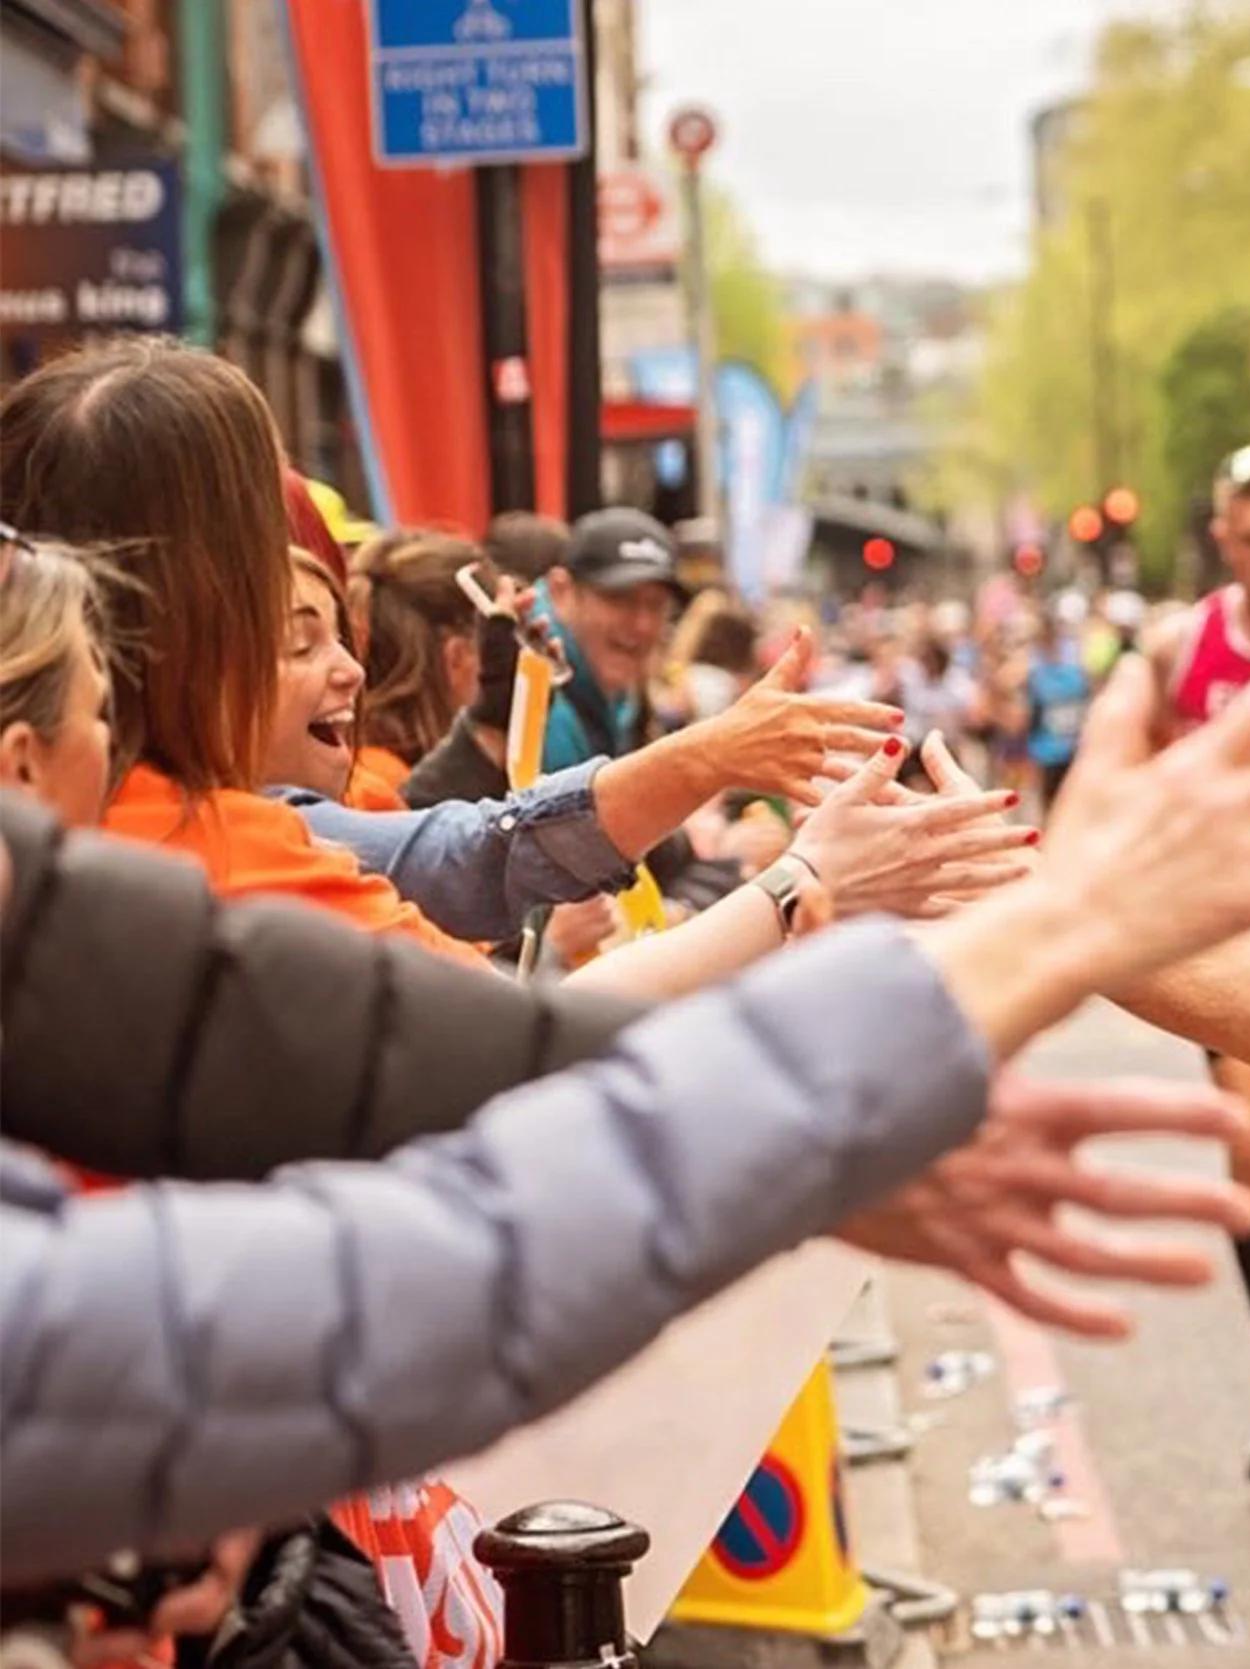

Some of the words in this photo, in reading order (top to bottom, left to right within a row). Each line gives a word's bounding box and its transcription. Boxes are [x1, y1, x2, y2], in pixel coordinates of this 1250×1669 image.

[385, 61, 475, 91] RIGHT
[488, 57, 569, 86] TURN
[466, 88, 537, 114] TWO
[420, 117, 542, 149] STAGES
[0, 172, 166, 225] TFRED
[77, 278, 169, 326] king
